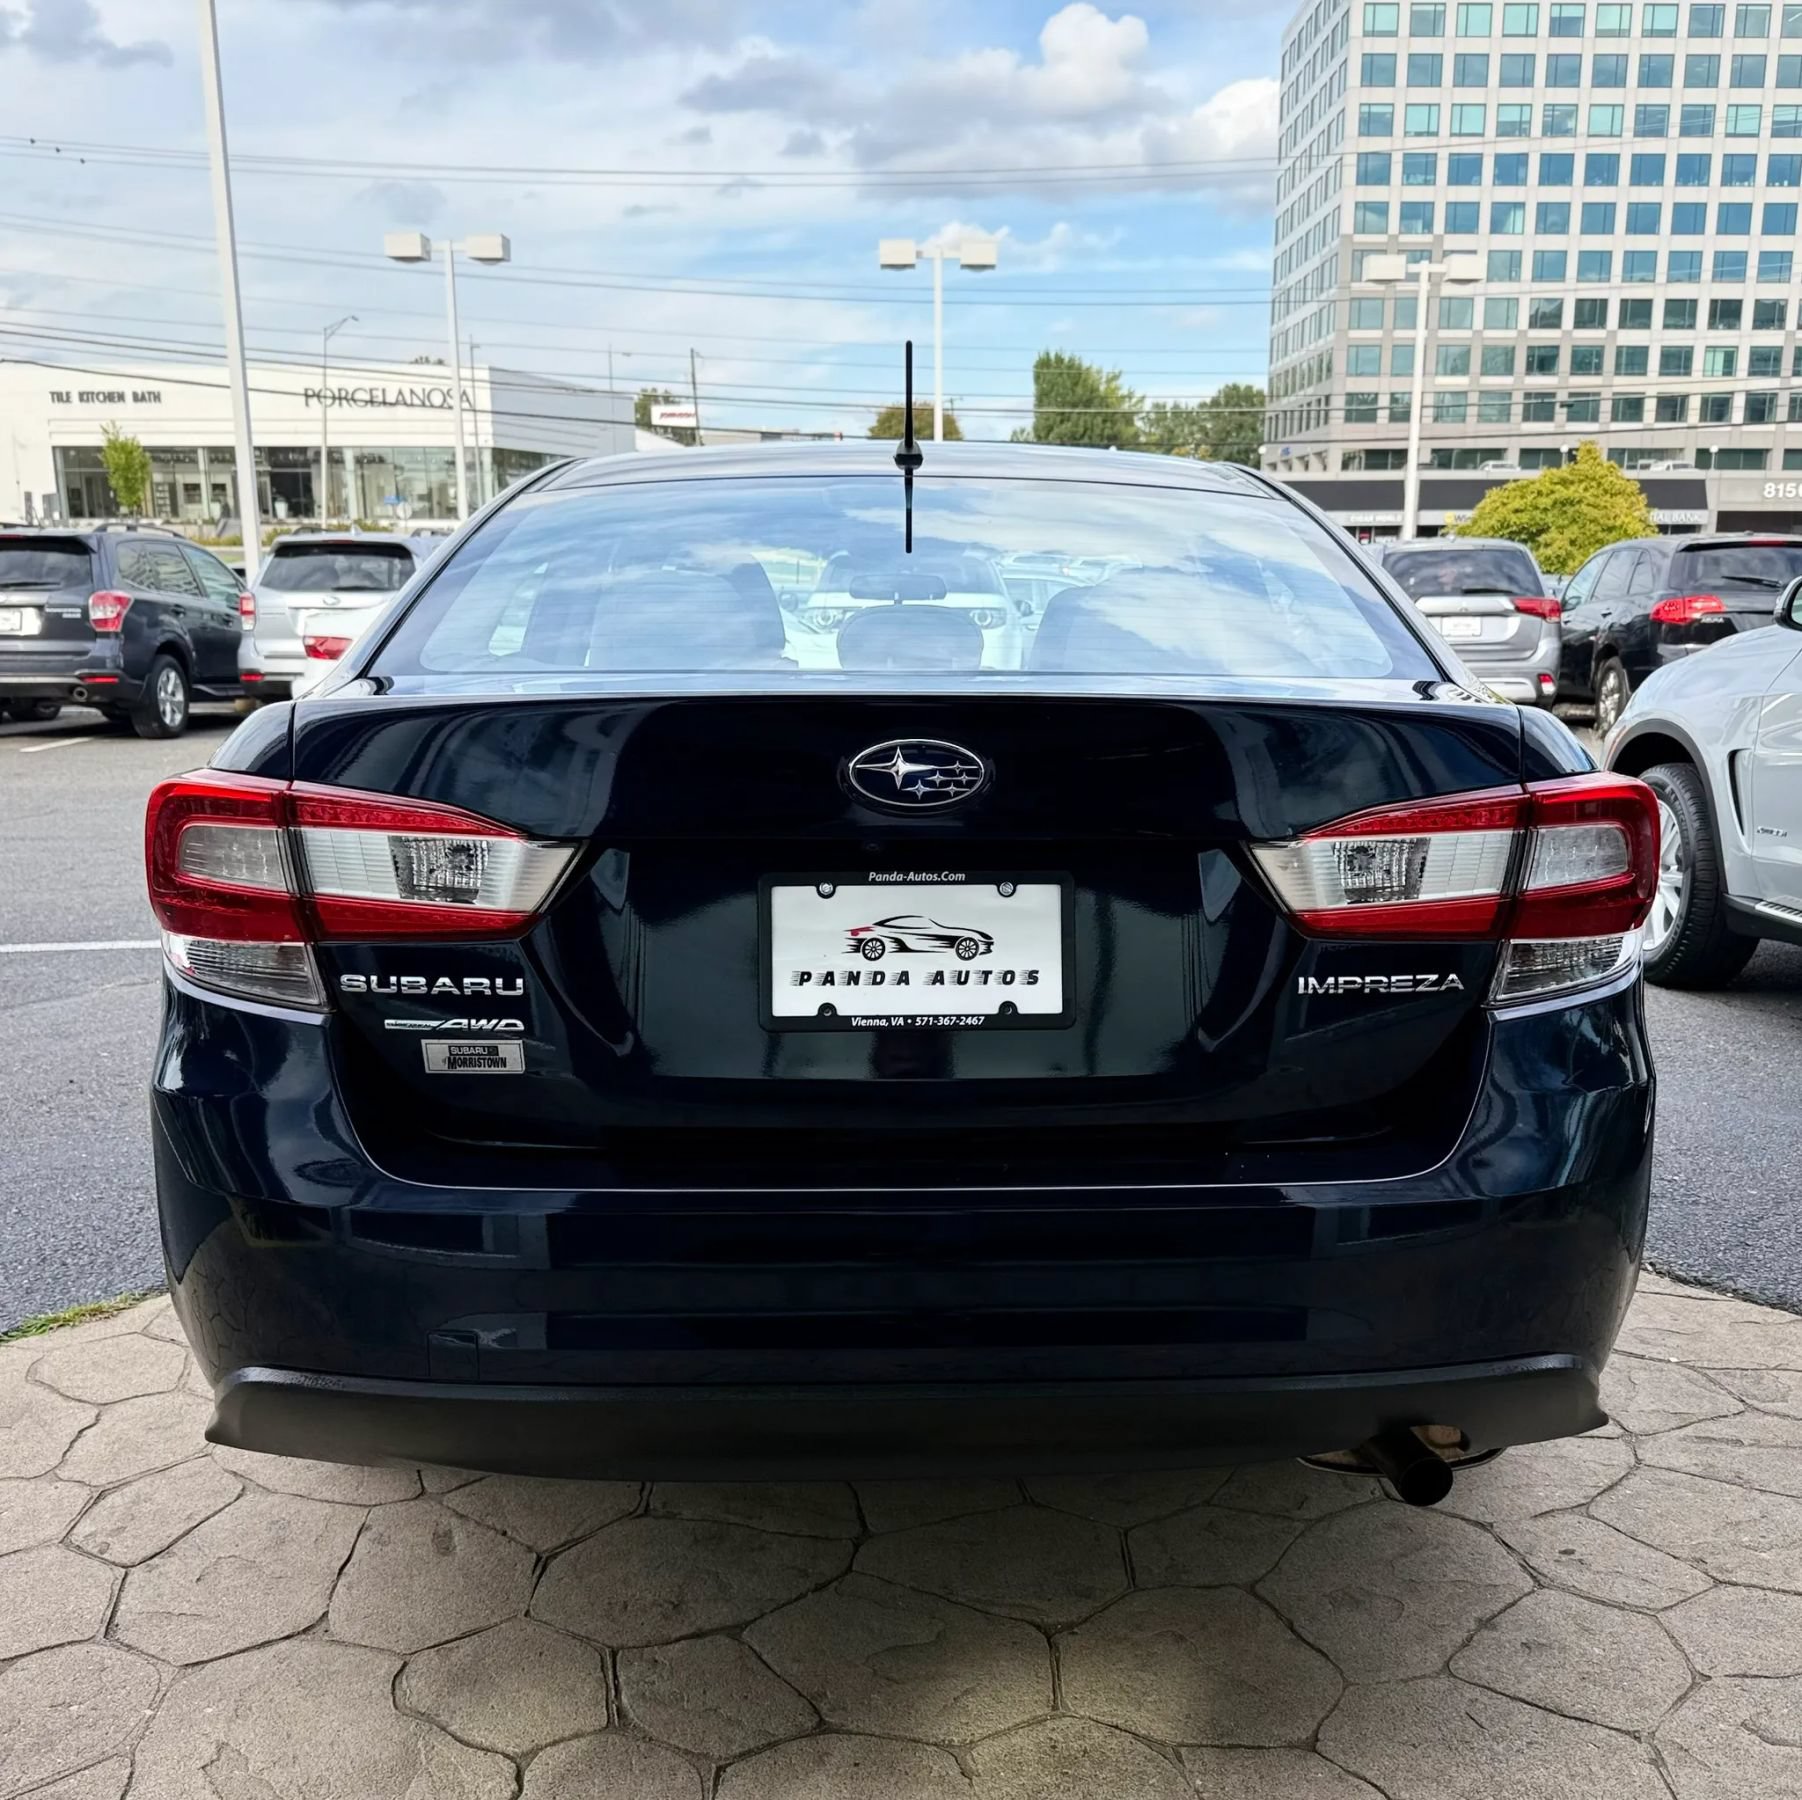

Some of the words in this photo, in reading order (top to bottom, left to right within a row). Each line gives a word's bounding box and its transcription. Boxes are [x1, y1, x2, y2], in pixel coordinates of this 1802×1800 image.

[49, 391, 72, 403] TILE
[78, 391, 125, 403] KITCHEN
[132, 391, 161, 403] BATH
[868, 870, 966, 882] Panda-Autos.Com
[790, 970, 910, 986] PANDA
[923, 969, 1040, 986] AUTOS
[1297, 973, 1465, 994] IMPREZA
[340, 974, 524, 996] SUBARU
[436, 1018, 525, 1031] AWD
[851, 1016, 889, 1027] Vienna,
[890, 1016, 904, 1026] VA
[915, 1015, 985, 1026] 571-367-2467
[450, 1046, 488, 1055] SUBARU
[448, 1056, 507, 1069] MORRISTOWN
